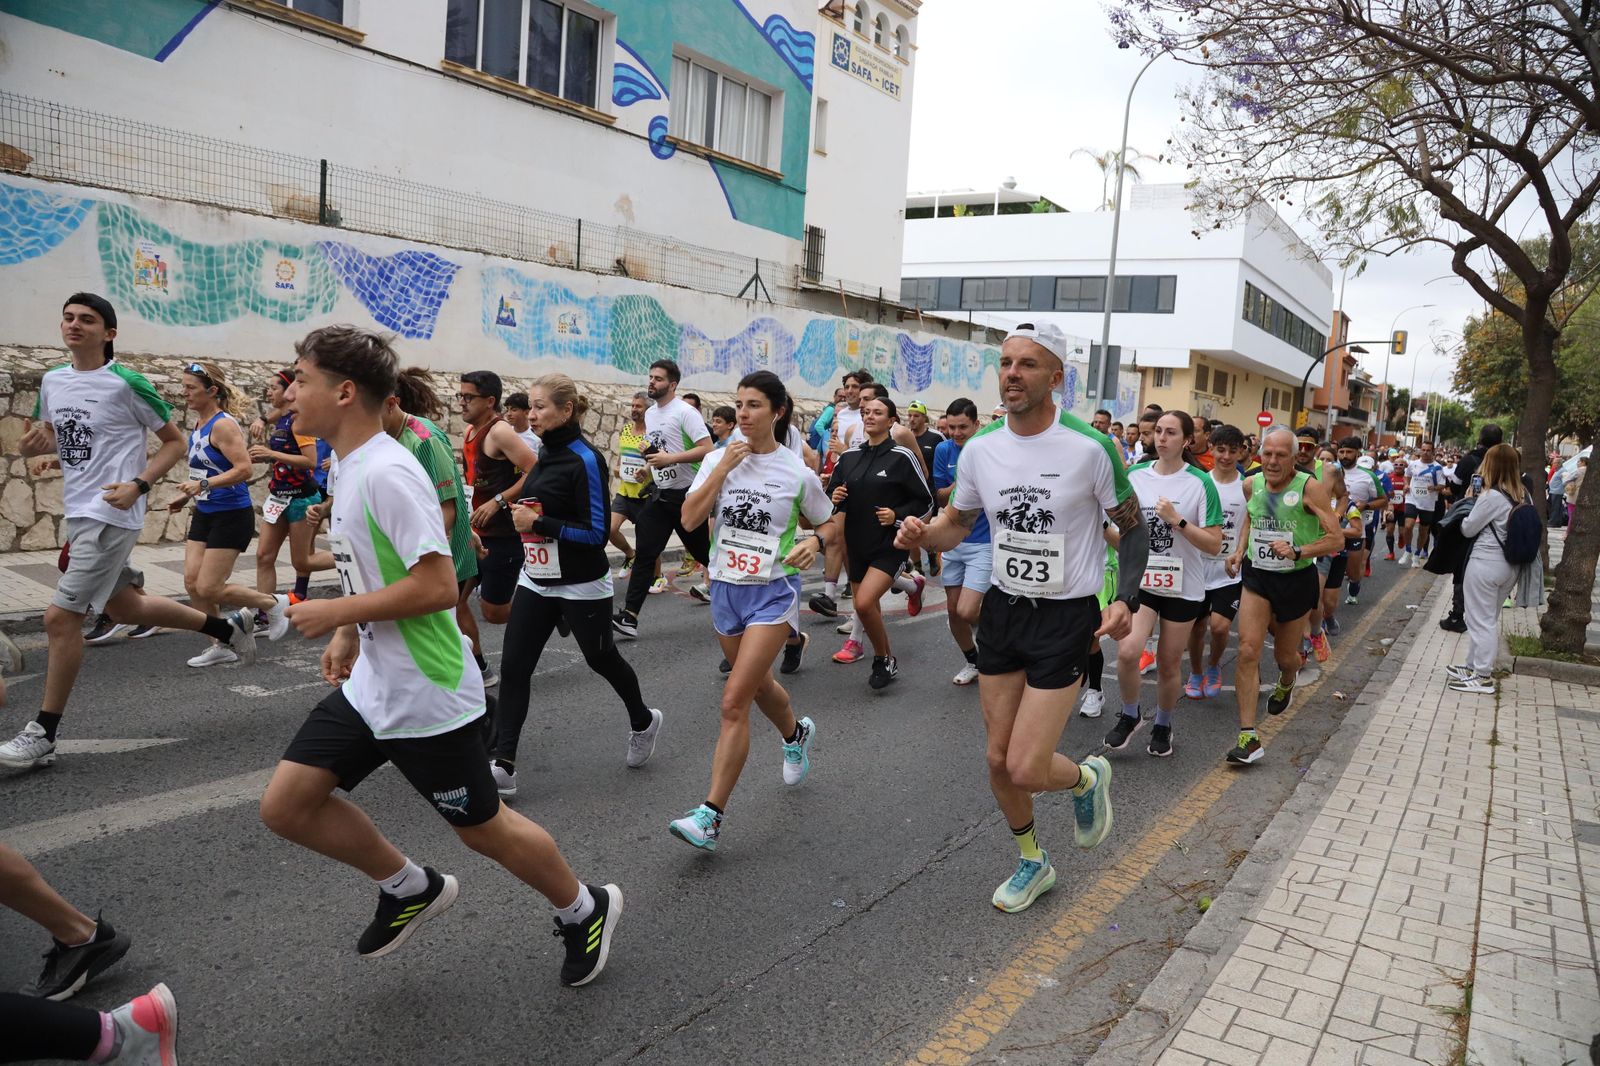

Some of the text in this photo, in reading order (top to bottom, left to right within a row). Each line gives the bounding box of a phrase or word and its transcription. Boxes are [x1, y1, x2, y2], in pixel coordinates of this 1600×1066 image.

[851, 62, 872, 82] SAFA
[882, 78, 899, 95] ICET
[275, 281, 294, 290] SAFA
[69, 449, 88, 459] PALO
[658, 468, 677, 482] 590
[727, 550, 760, 575] 363
[1006, 557, 1050, 583] 623
[1143, 572, 1174, 588] 153
[433, 786, 467, 801] PUMA
